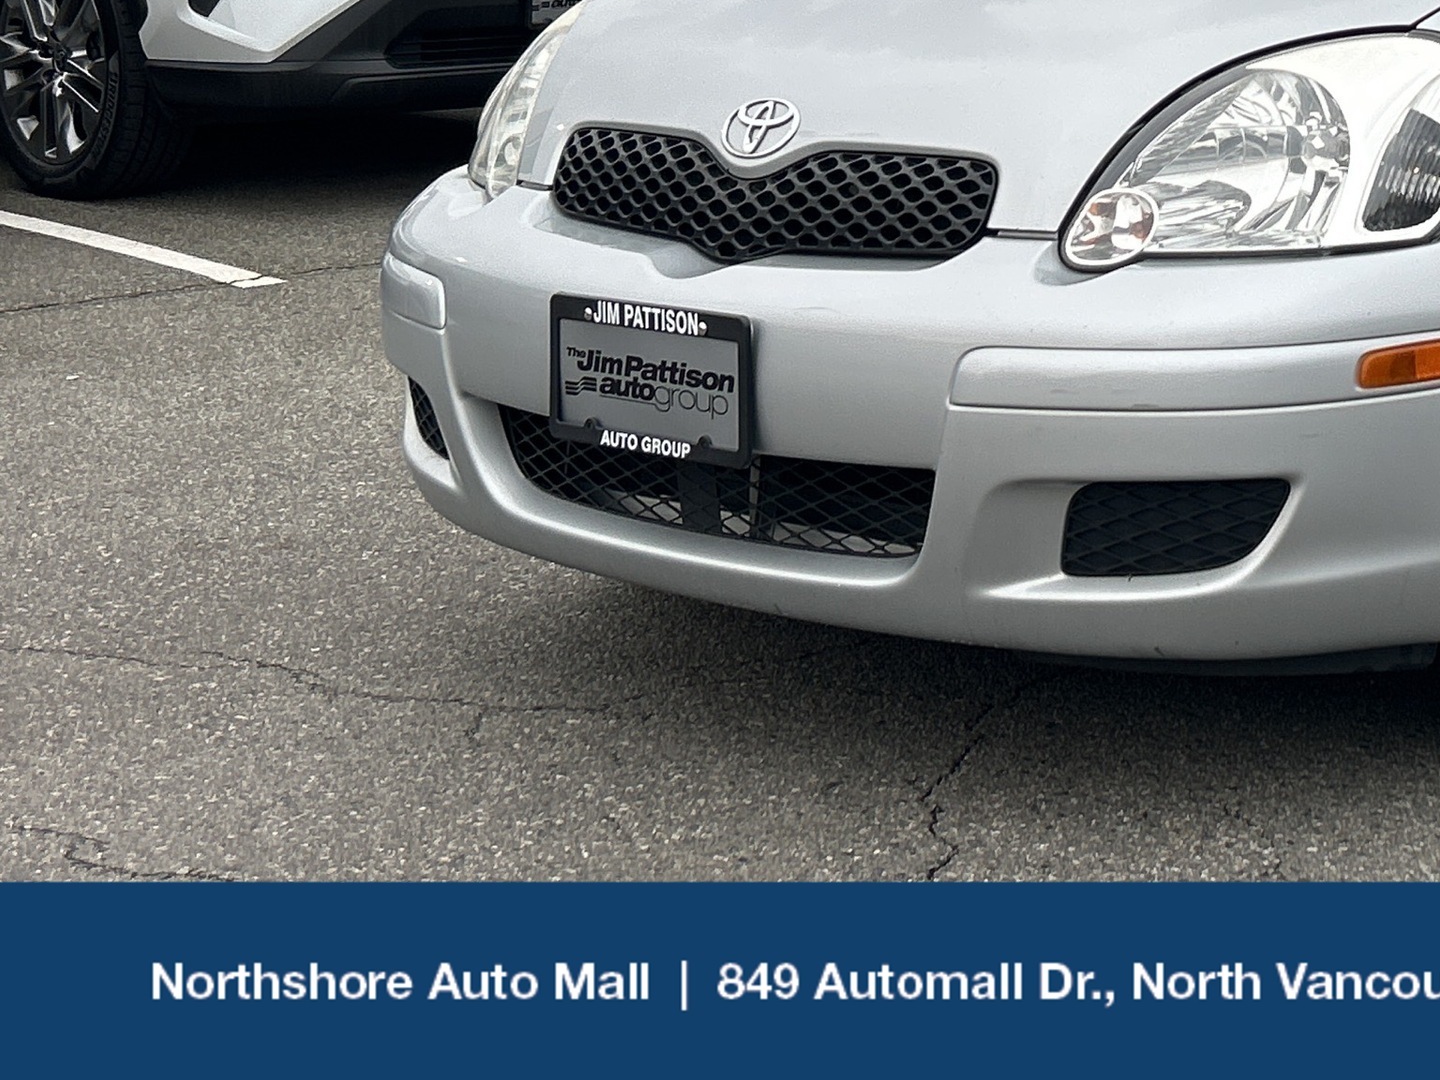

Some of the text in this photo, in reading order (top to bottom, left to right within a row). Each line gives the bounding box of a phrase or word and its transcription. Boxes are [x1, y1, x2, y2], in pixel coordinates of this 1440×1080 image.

[593, 300, 700, 336] JIM PATTISON
[566, 346, 586, 359] The
[600, 429, 692, 459] AUTO GROUP
